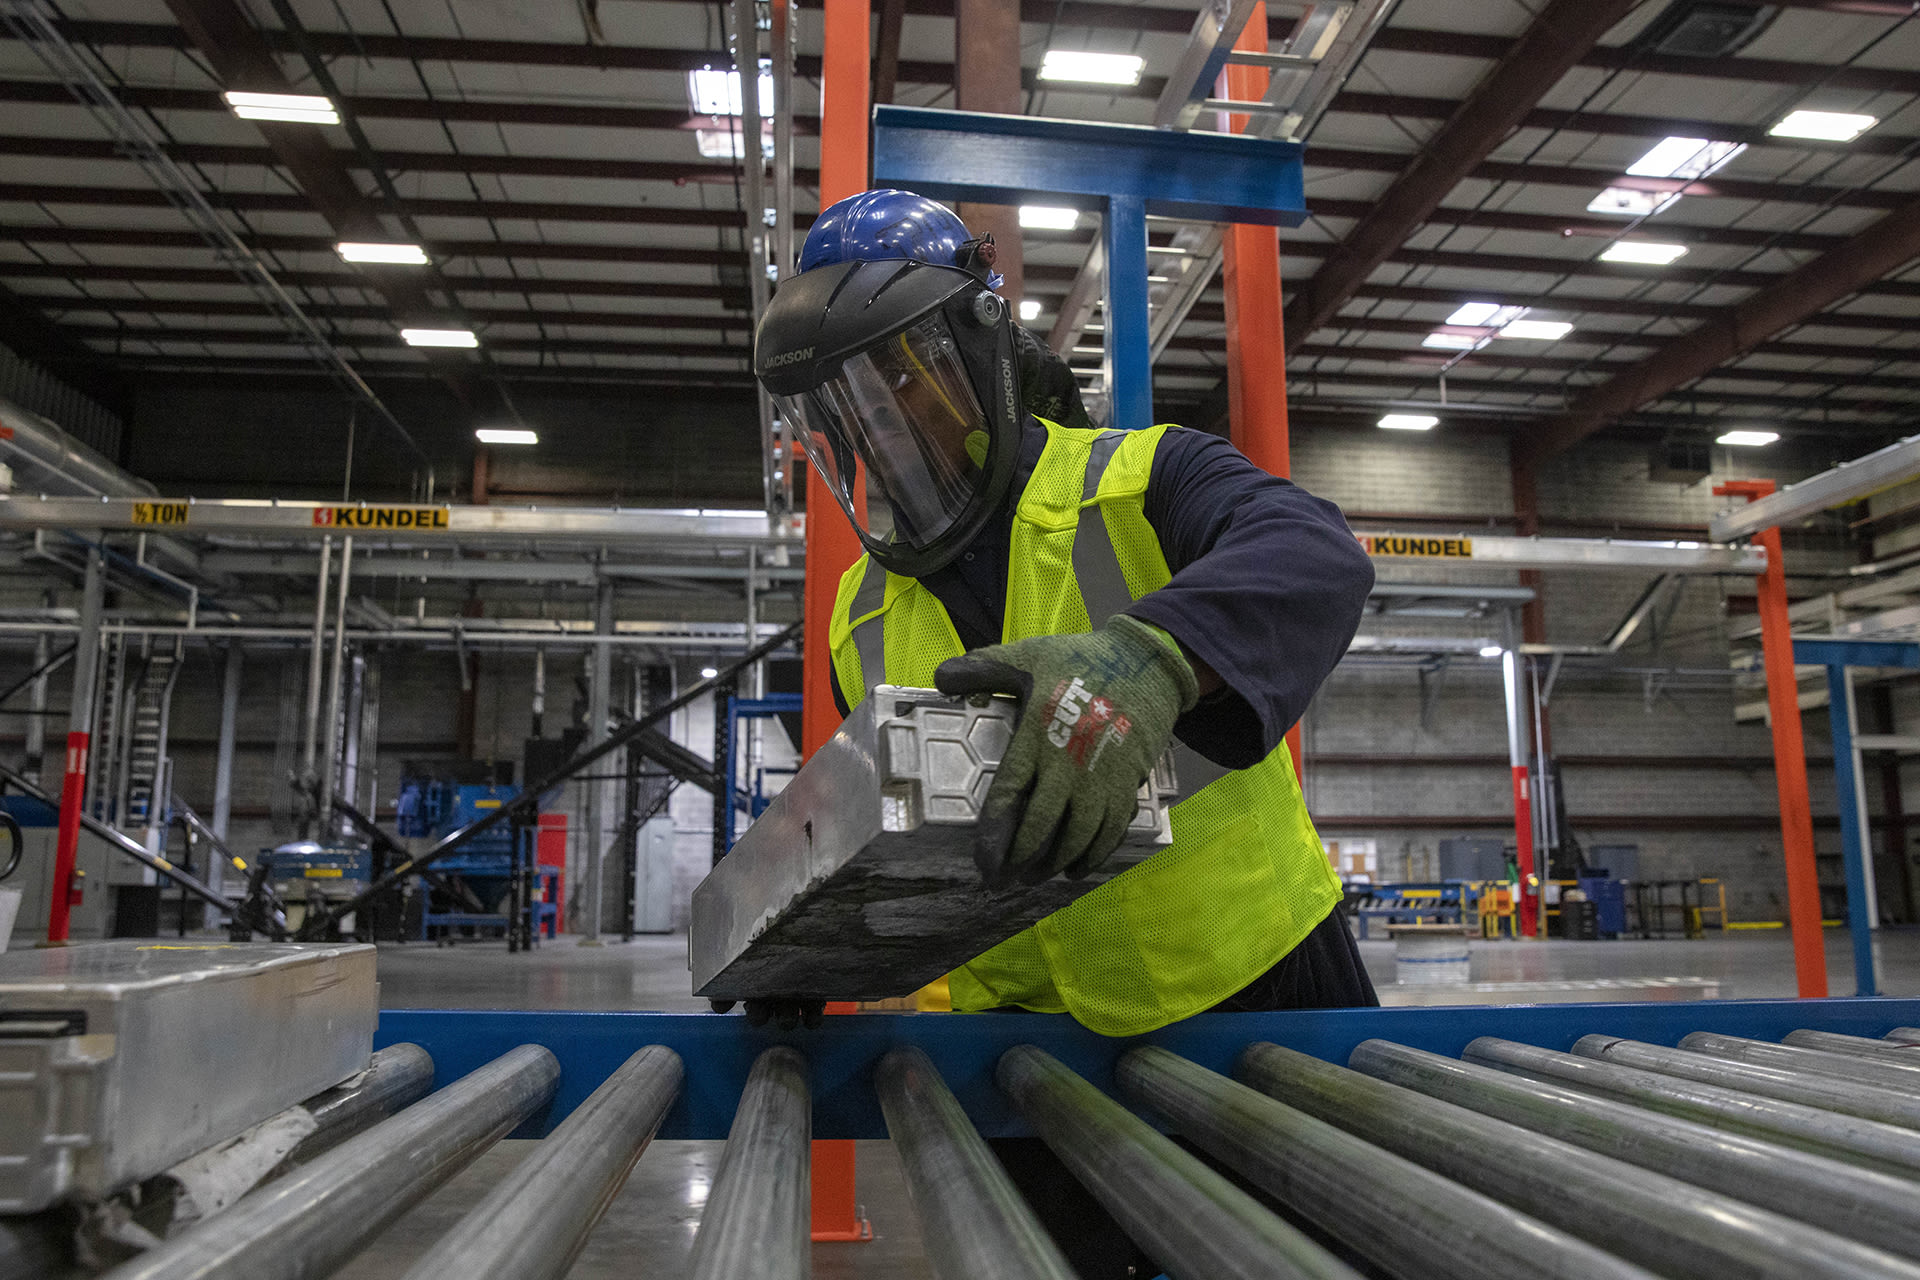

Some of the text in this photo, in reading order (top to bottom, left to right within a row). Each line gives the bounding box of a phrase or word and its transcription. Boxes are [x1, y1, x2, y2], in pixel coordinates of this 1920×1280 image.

[764, 347, 813, 369] JACKSON
[1001, 358, 1017, 424] JACKSON
[152, 504, 188, 522] TON
[336, 508, 447, 527] KUNDEL
[1375, 538, 1471, 556] KUNDEL
[1047, 677, 1093, 748] CUT
